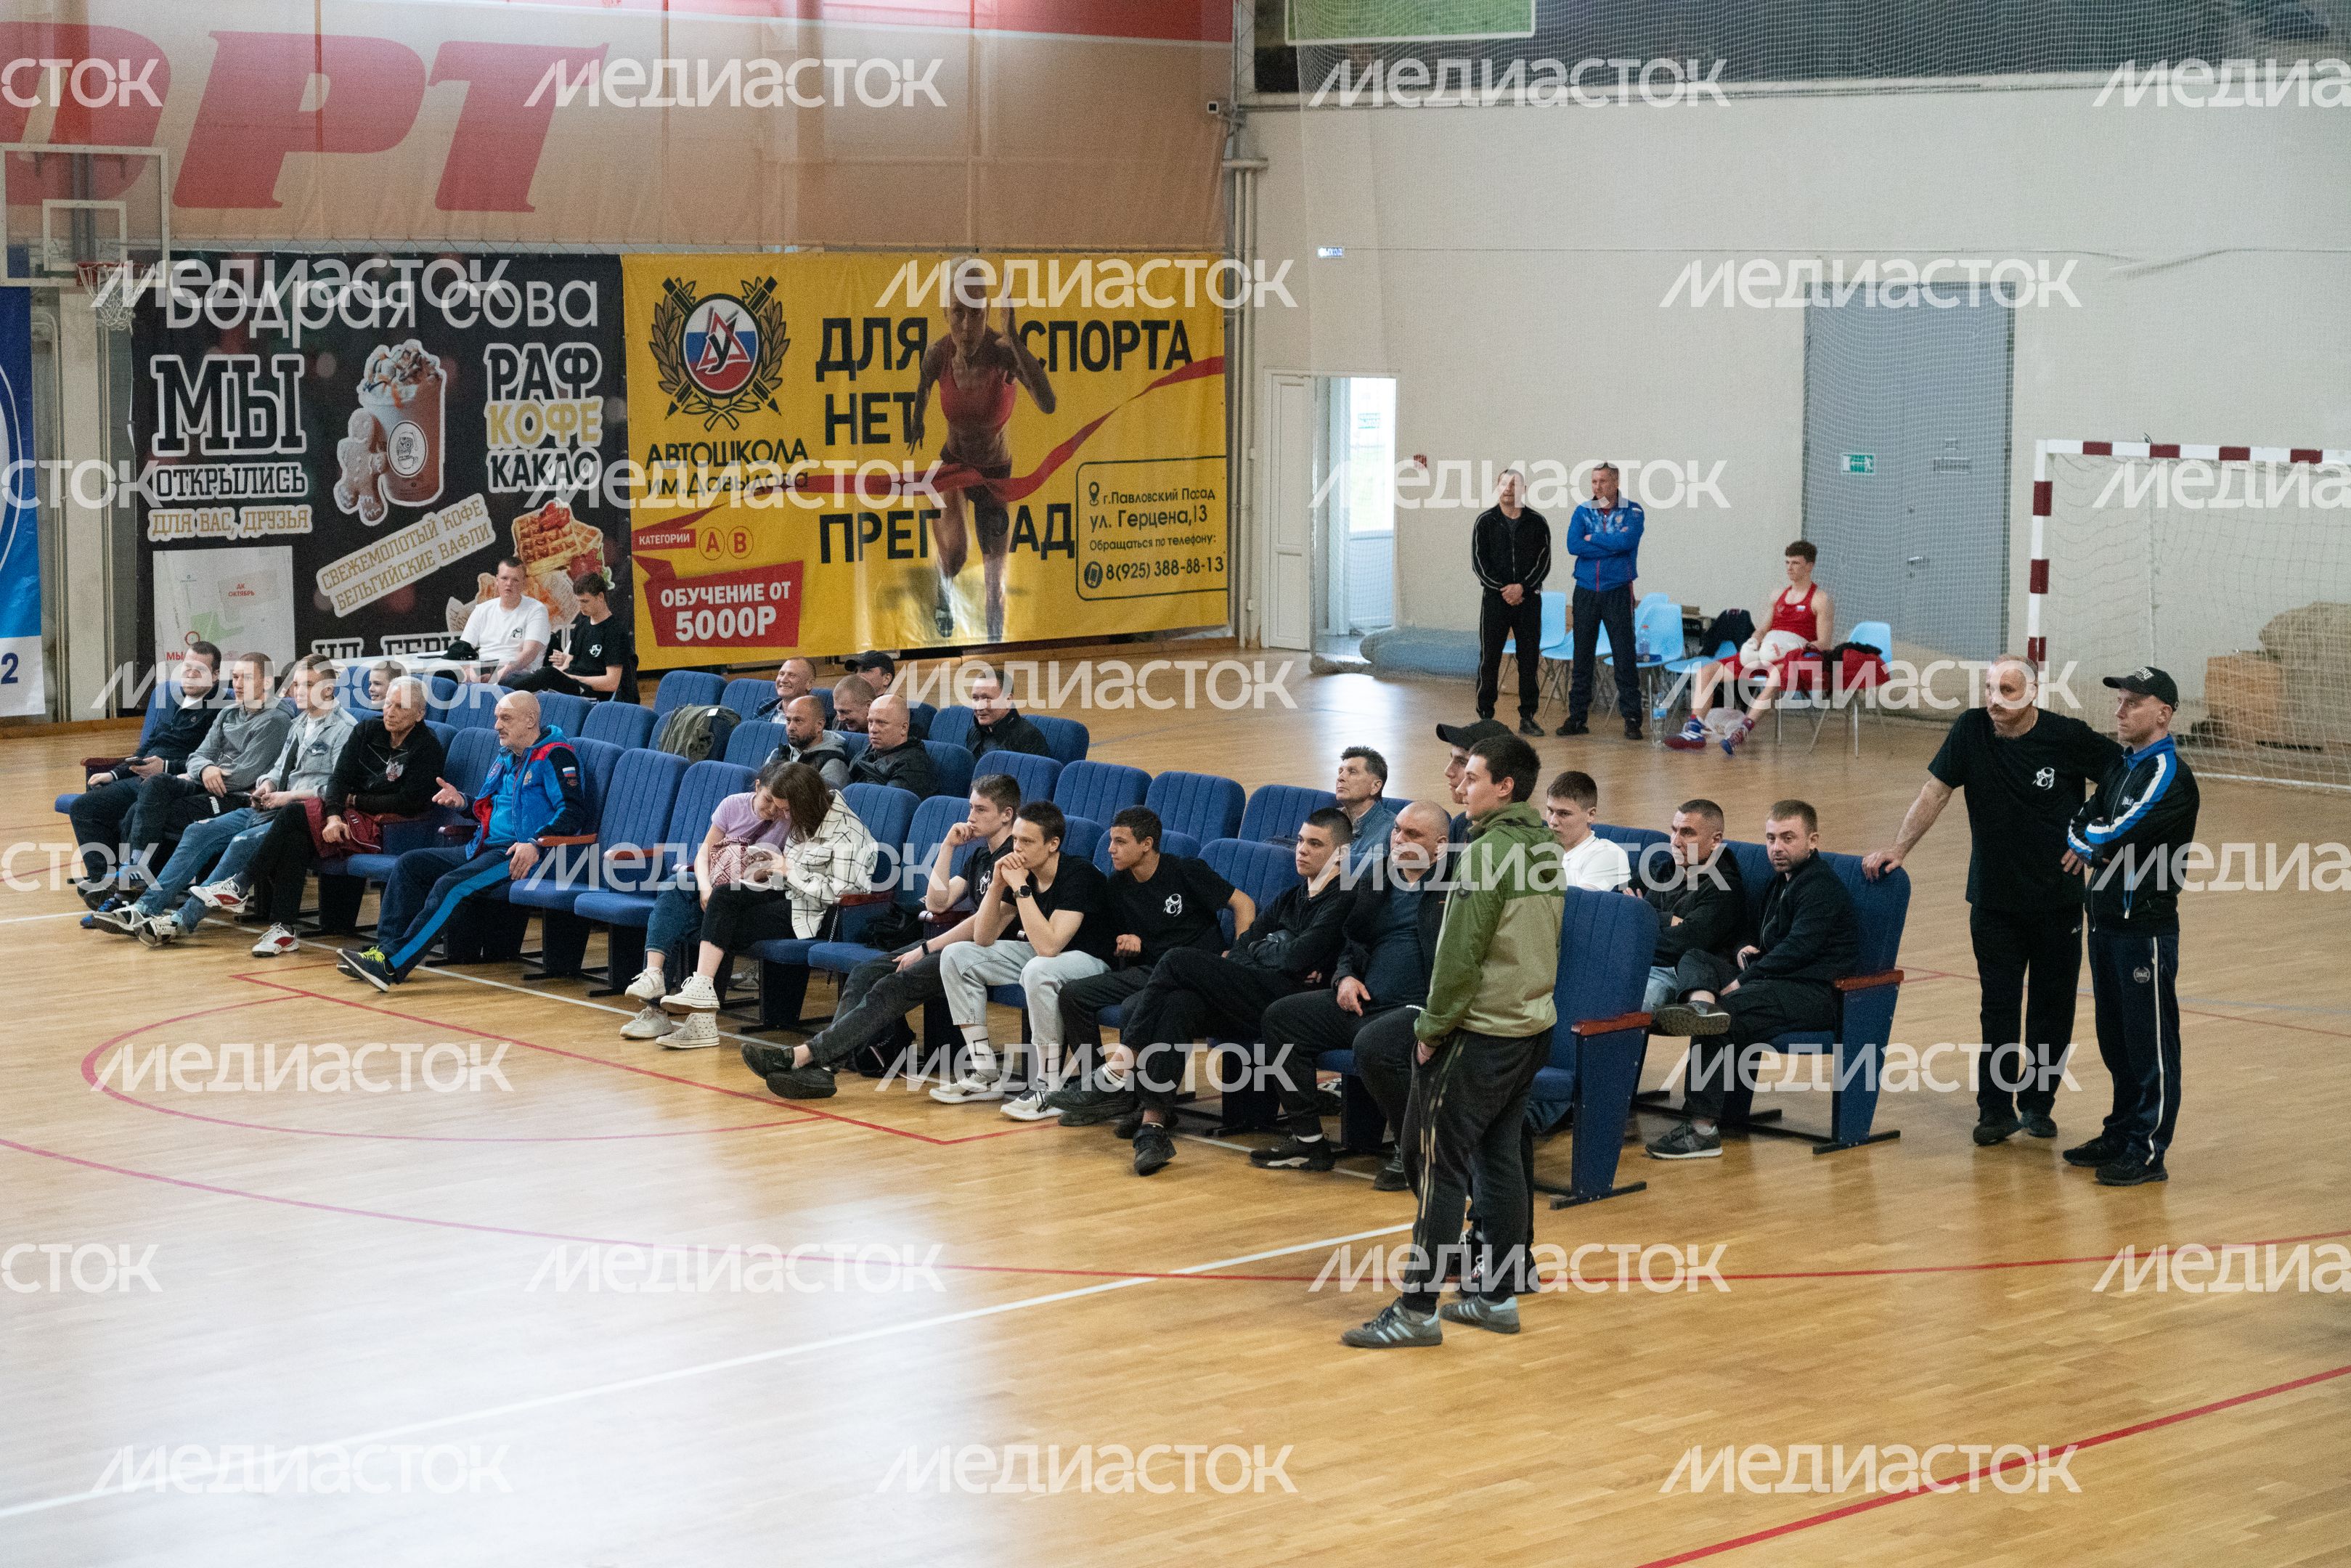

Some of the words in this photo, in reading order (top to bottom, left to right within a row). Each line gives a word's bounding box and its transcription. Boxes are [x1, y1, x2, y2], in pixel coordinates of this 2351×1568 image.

[815, 317, 929, 382] ДЛЯ
[1019, 319, 1193, 372] СПОРТА
[486, 345, 600, 401] РАФ
[151, 355, 305, 454] МЫ
[487, 401, 600, 446] КОФЕ
[825, 392, 918, 446] НЕТ
[490, 450, 599, 489] КАКАО
[645, 438, 809, 470] АВТОШКОЛА
[155, 465, 306, 498] ОТКРЫЛИСЬ
[152, 513, 192, 536] ДЛЯ
[199, 511, 235, 536] ВАС,
[243, 510, 309, 533] ДРУЗЬЯ
[639, 534, 690, 545] КАТЕГОРИИ
[819, 503, 1075, 565] ПРЕГАД
[1090, 515, 1112, 533] ул.
[321, 518, 439, 591] СВЕЖЕМОЛОТЫЙ
[441, 499, 484, 531] КОФЕ
[1090, 538, 1153, 552] Обращаться
[335, 550, 436, 611] БЕЛЬГИЙСКИЕ
[438, 522, 492, 560] ВАФЛИ
[1106, 563, 1151, 581] 8(925)
[1154, 556, 1224, 577] 388-88-13
[661, 583, 765, 608] ОБУЧЕНИЕ
[770, 581, 791, 600] ОТ
